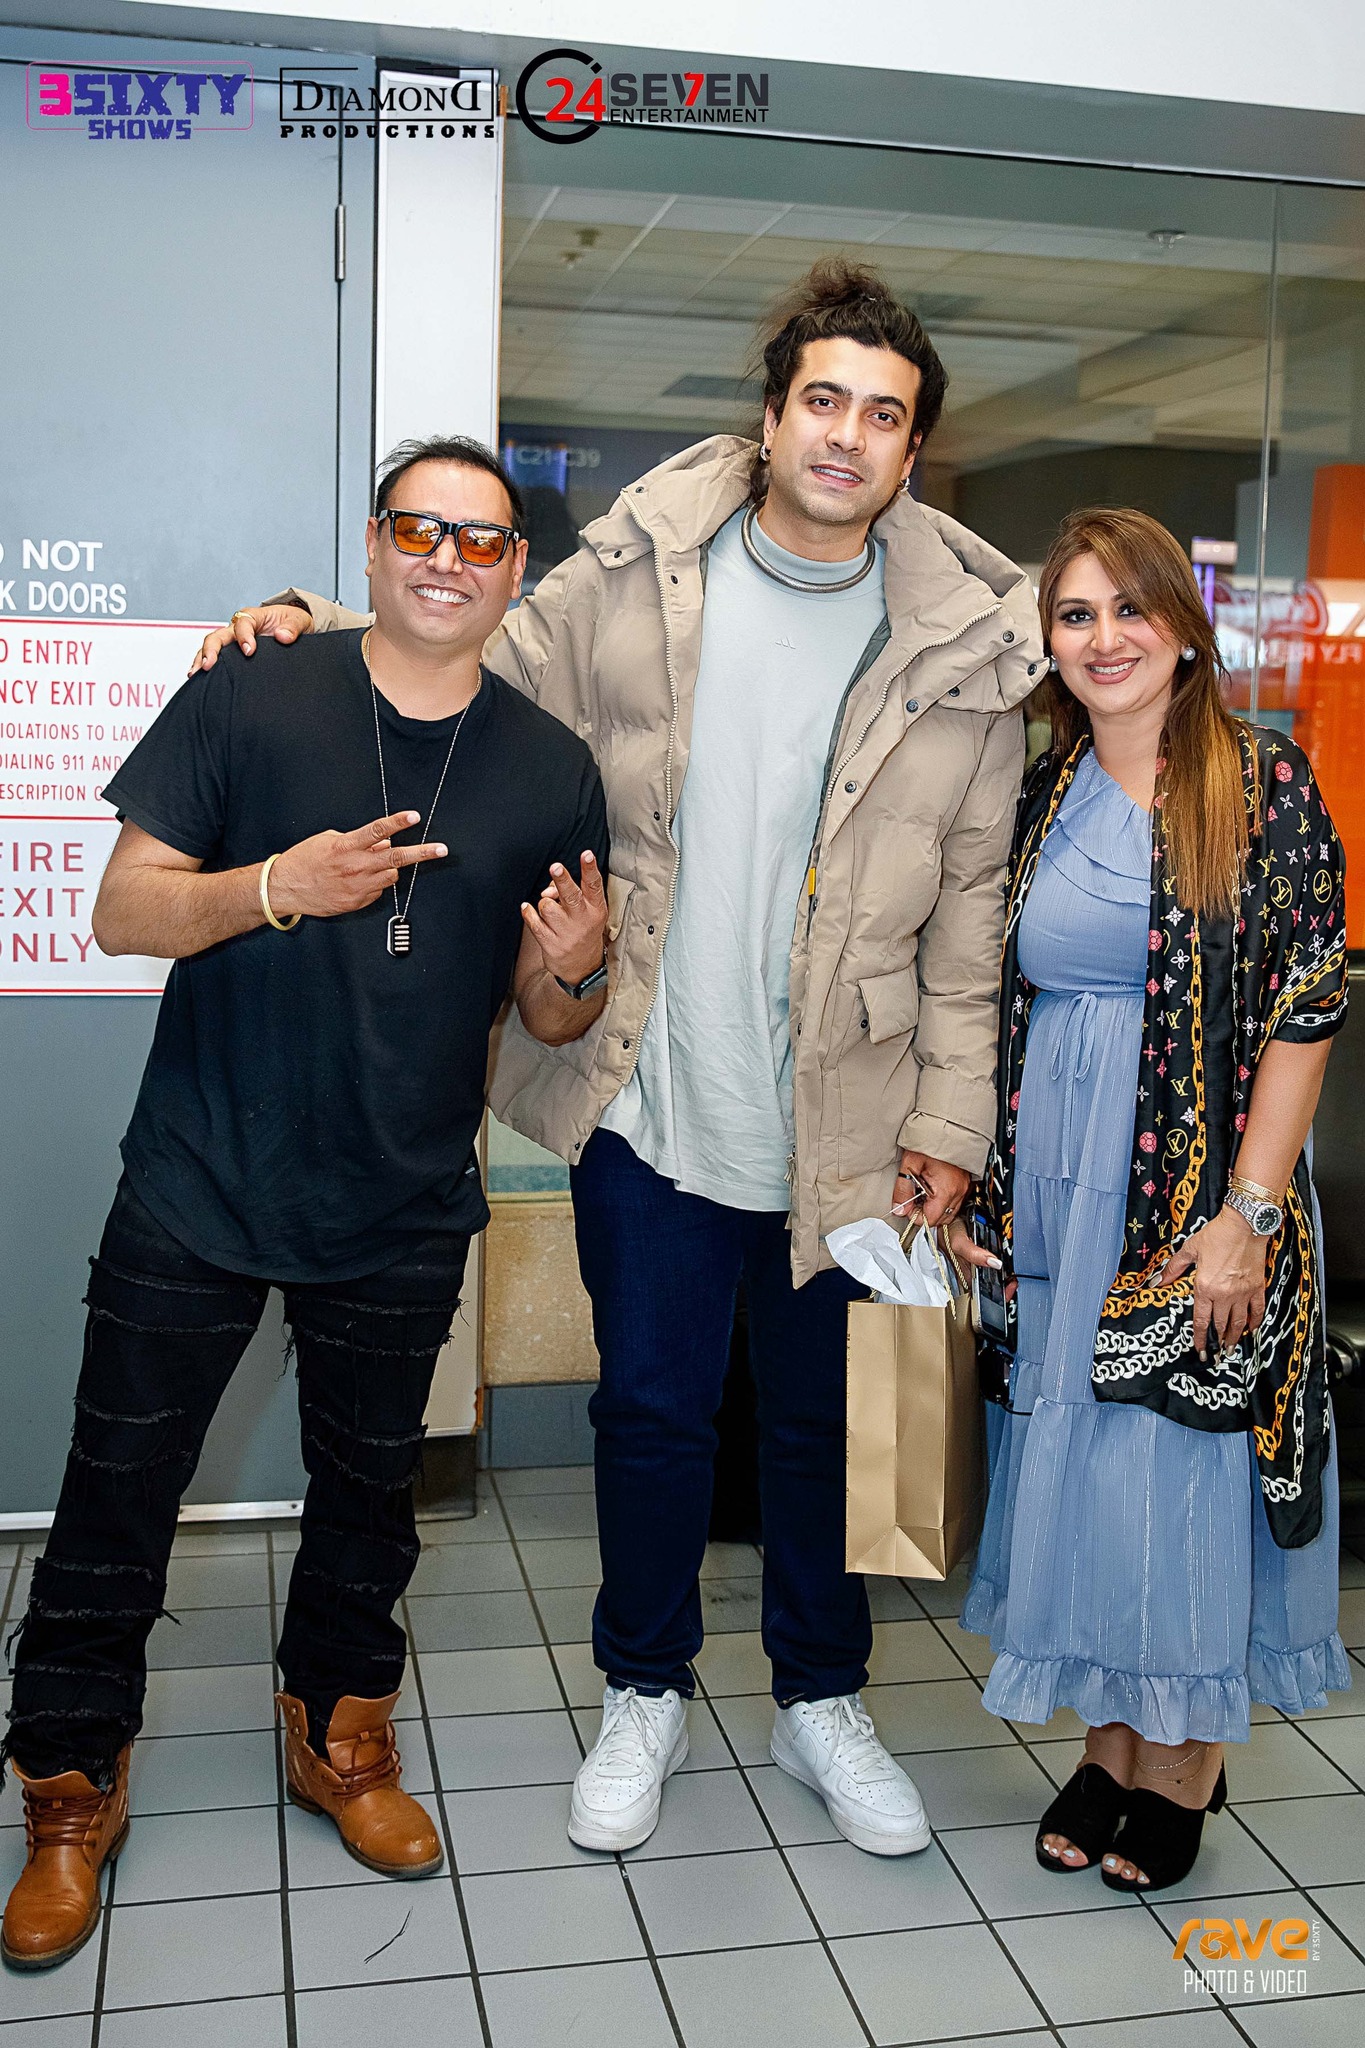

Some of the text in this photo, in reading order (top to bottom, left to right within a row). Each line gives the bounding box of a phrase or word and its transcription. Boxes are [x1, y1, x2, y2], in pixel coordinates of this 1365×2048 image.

[22, 538, 103, 572] NOT
[28, 580, 128, 615] DOORS
[23, 639, 93, 665] ENTRY
[51, 681, 96, 706] EXIT
[108, 682, 166, 708] ONLY
[86, 724, 104, 741] TO
[112, 725, 143, 741] LAW
[0, 753, 122, 771] IALING 911 AND
[0, 842, 84, 872] IRE
[0, 888, 85, 918] XIT
[0, 932, 94, 962] NLY
